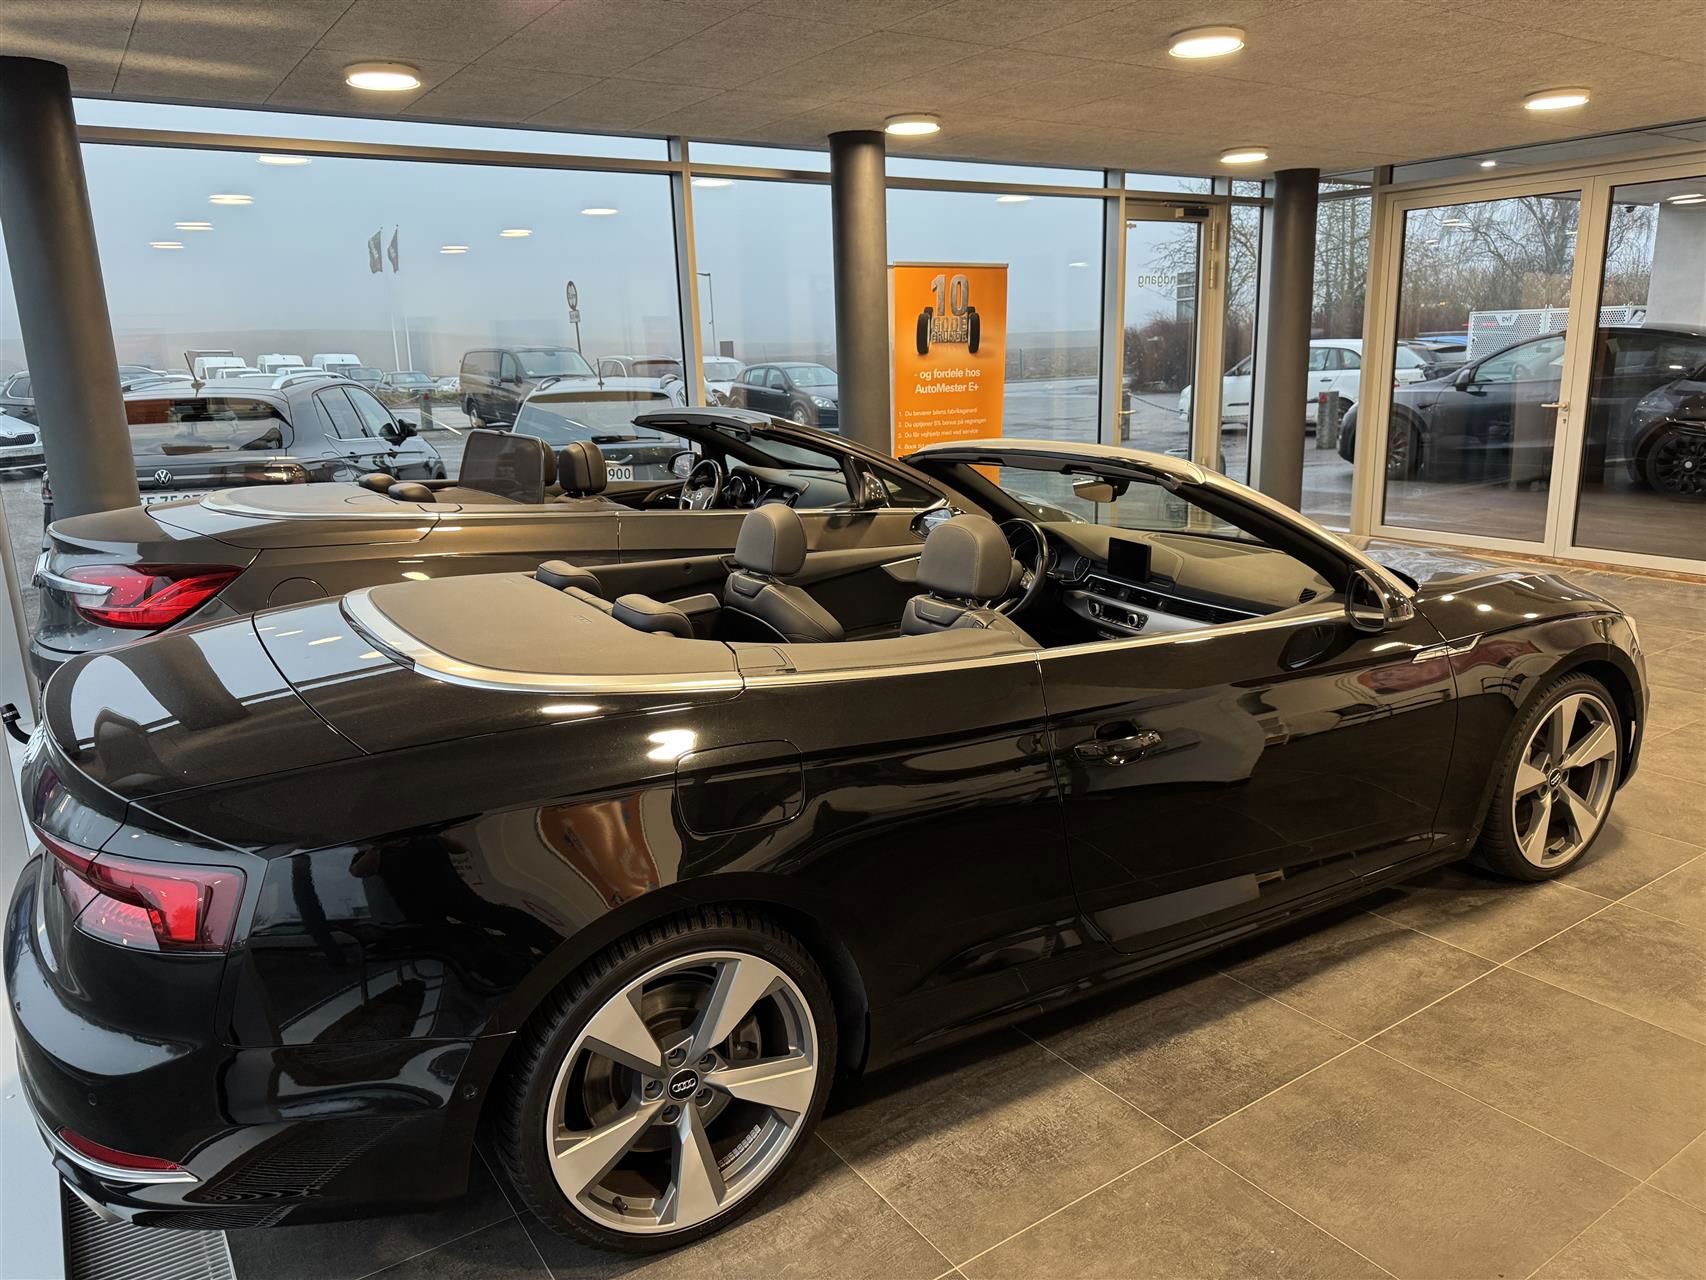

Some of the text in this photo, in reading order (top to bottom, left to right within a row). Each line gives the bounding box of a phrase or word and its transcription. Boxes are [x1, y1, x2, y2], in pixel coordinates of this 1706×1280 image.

[931, 274, 969, 316] 10
[919, 370, 932, 381] og
[933, 368, 964, 378] fordele
[965, 367, 981, 377] hos
[915, 381, 979, 394] AutoMester E+
[608, 468, 631, 480] 900
